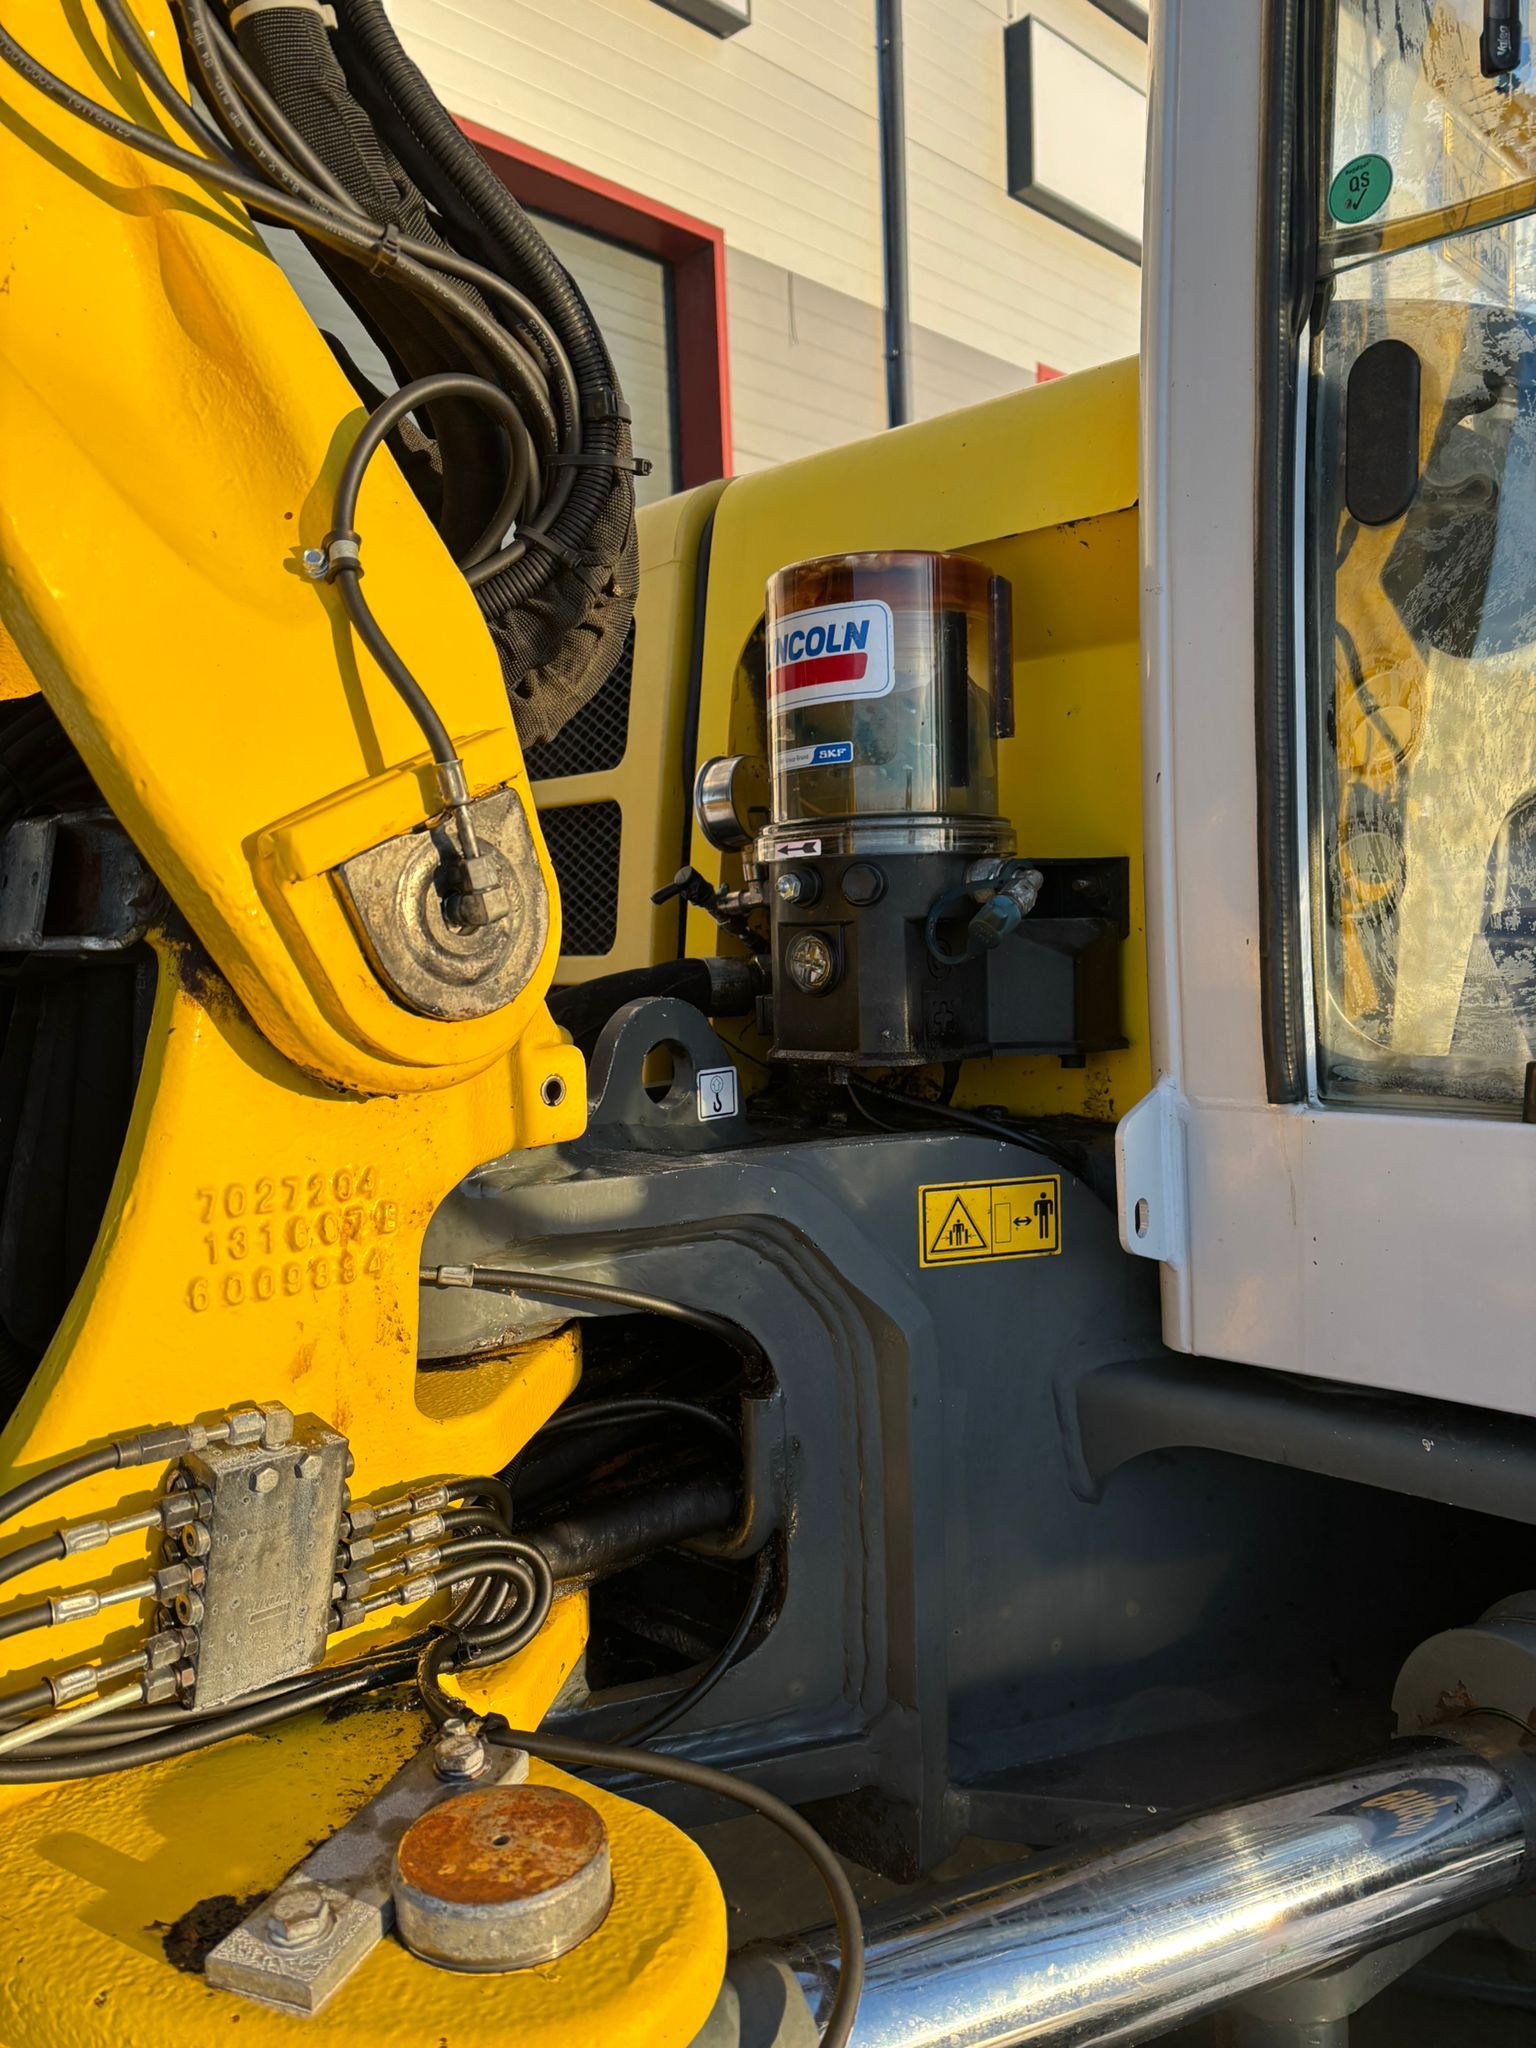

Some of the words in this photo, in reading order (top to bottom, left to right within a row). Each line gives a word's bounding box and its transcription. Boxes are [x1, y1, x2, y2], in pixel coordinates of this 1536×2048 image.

[1349, 171, 1370, 192] QS
[818, 747, 847, 759] SKF
[196, 1165, 379, 1225] 7027204
